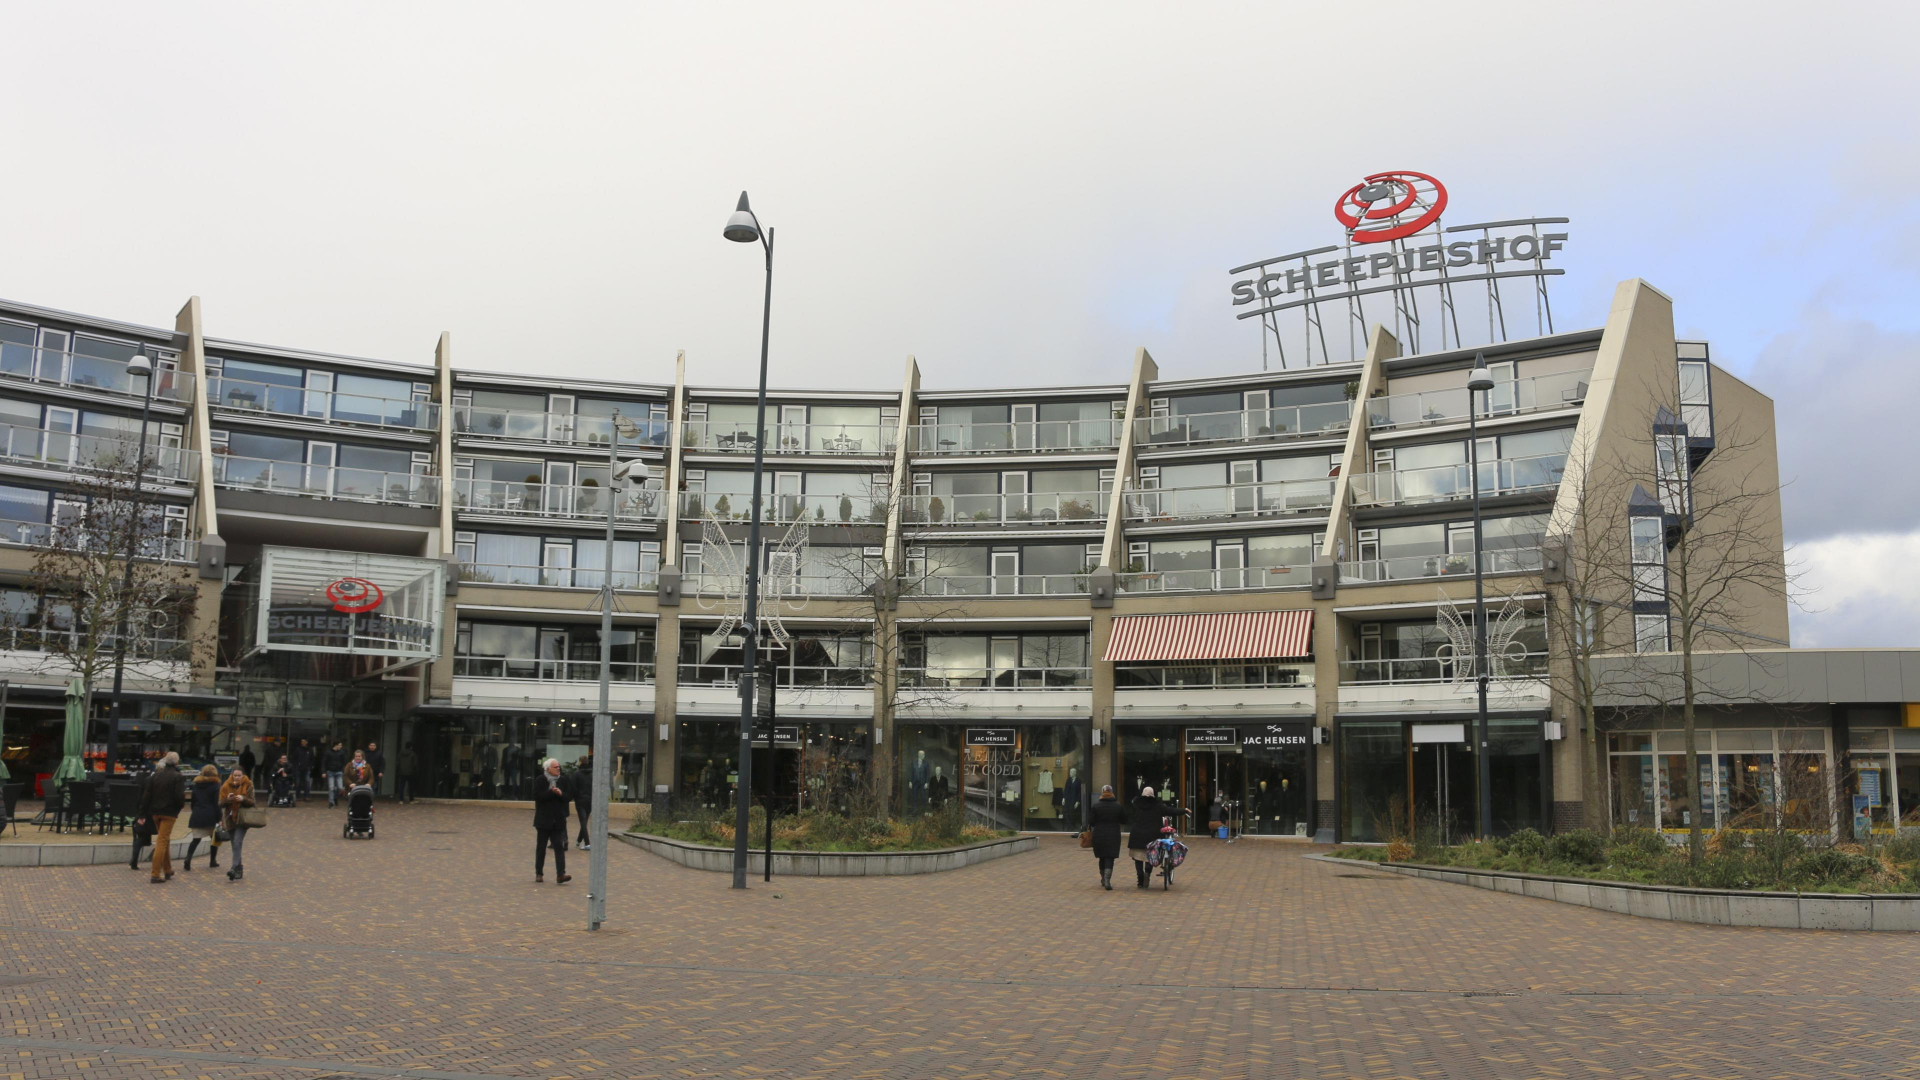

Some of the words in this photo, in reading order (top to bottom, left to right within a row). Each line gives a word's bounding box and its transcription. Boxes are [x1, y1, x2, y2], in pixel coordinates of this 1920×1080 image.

[1231, 232, 1568, 306] SCHEEPJESHOF
[266, 615, 434, 639] SCHEEPJESHOF
[1243, 736, 1262, 745] JAC
[1264, 736, 1306, 745] HENSEN
[981, 764, 1021, 776] GOED
